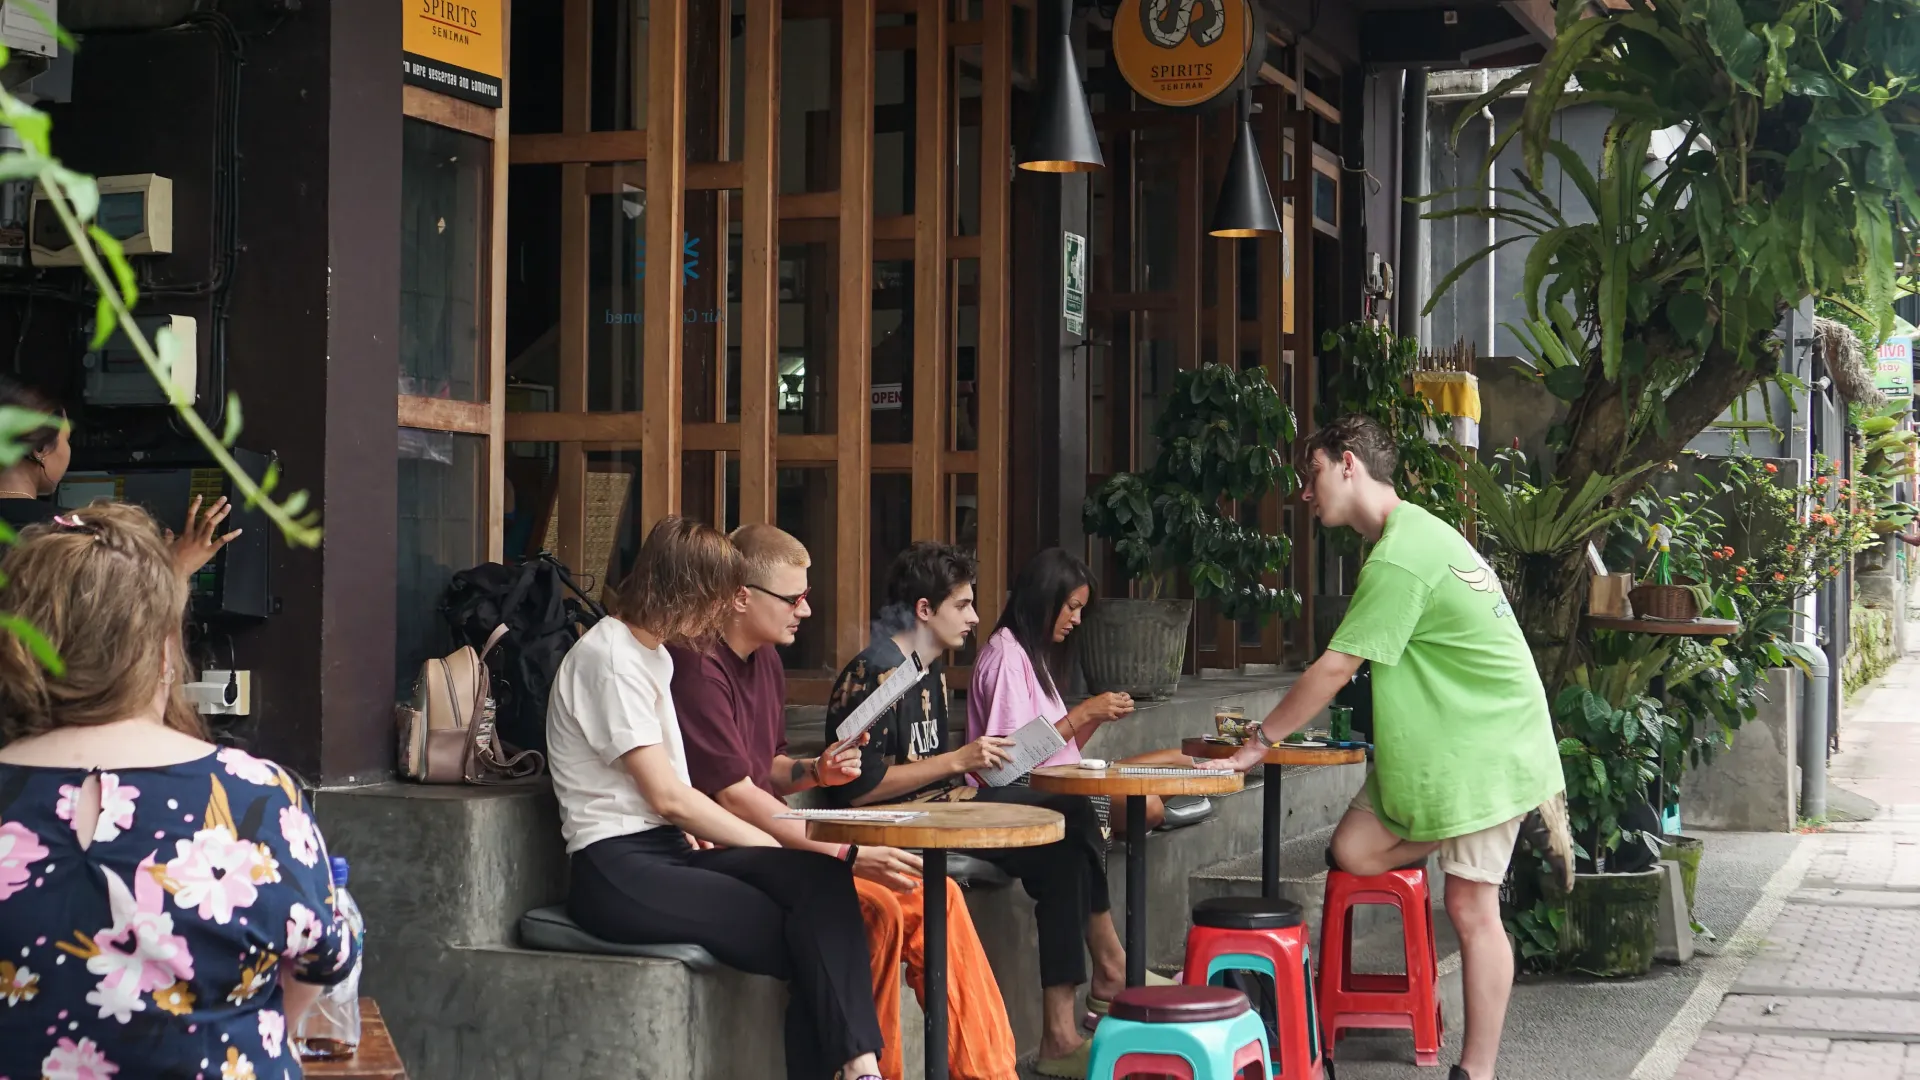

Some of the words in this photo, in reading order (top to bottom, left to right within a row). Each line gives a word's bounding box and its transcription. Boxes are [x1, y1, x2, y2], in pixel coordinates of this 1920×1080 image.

[423, 0, 477, 28] SPIRITS
[432, 26, 469, 45] SENIMAN
[1151, 63, 1213, 78] SPIRITS
[428, 68, 457, 86] yesterday
[459, 76, 469, 89] and
[471, 79, 498, 97] tomorrow
[1160, 82, 1203, 91] SENIMAN
[871, 391, 904, 404] OPEN
